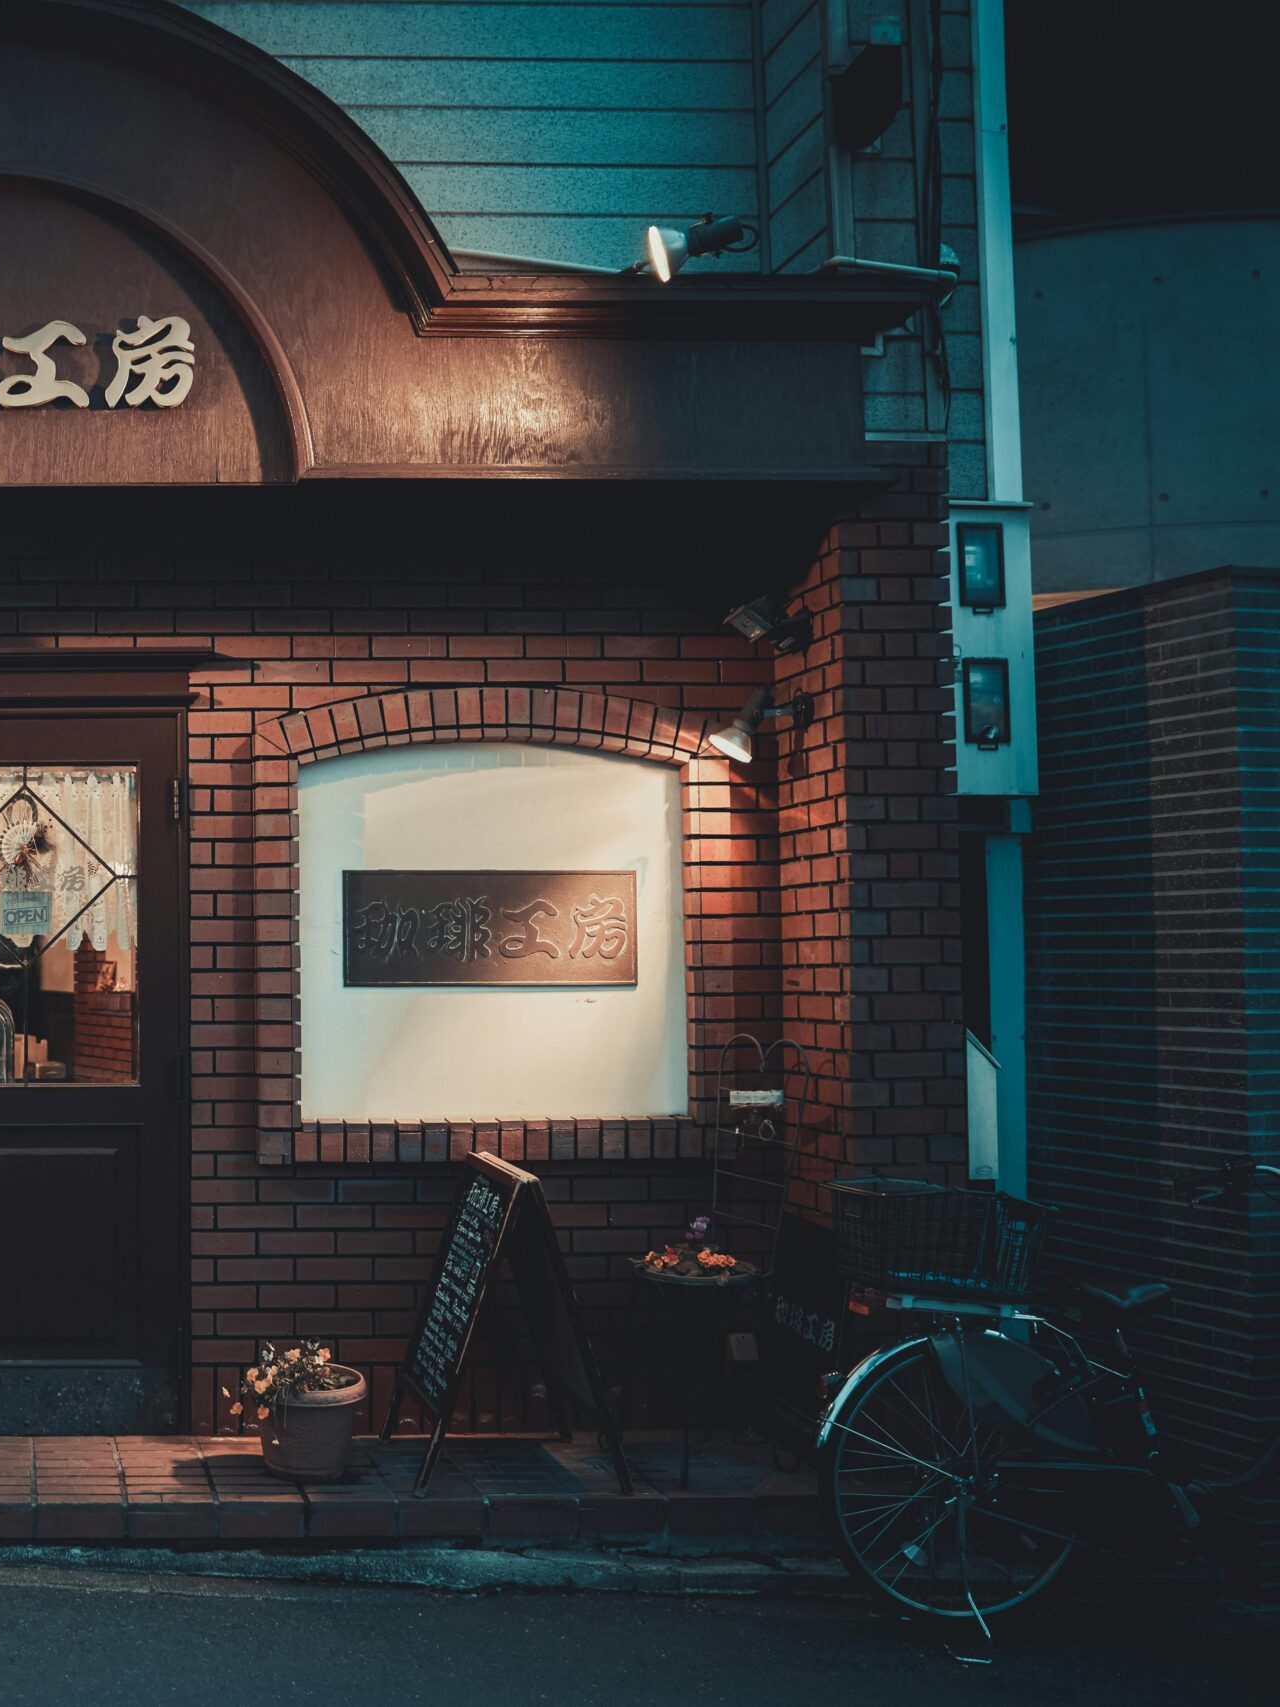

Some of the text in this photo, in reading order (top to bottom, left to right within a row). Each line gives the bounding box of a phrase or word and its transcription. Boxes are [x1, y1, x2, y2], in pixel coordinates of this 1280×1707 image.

[5, 908, 45, 924] OPEN
[353, 892, 628, 962] 珈琲工房
